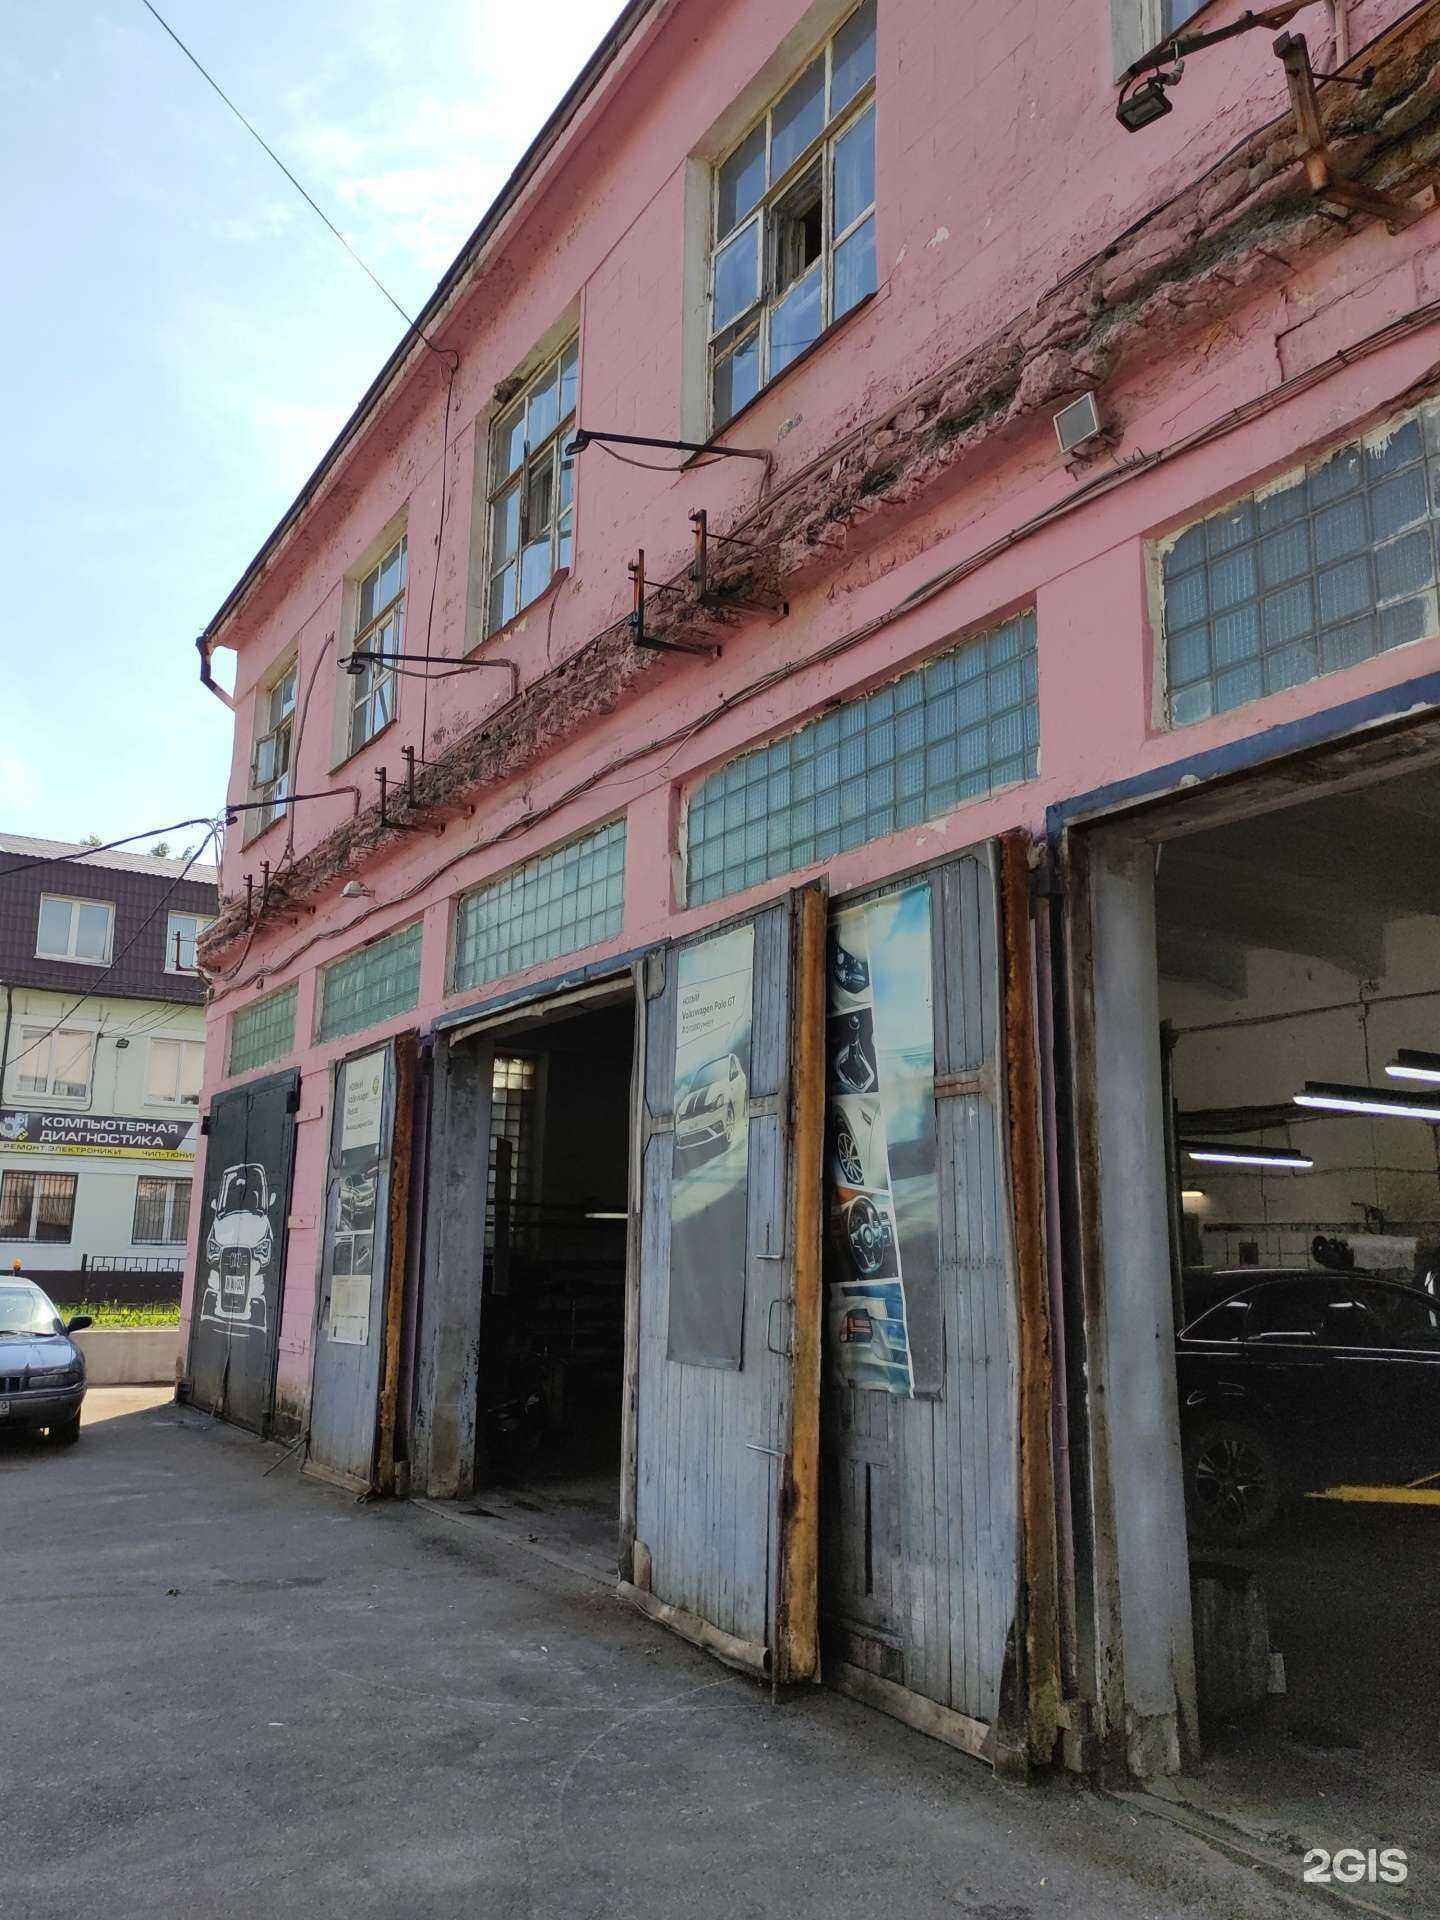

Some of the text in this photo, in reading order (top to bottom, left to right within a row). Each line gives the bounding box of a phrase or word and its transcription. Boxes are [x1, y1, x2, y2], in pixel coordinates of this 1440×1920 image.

[681, 995, 736, 1020] Volkswagen Polo GT
[41, 1116, 178, 1134] КОМПЬЮТЕРНАЯ
[39, 1130, 164, 1147] ДИАГНОСТИКА
[3, 1143, 44, 1152] РЕМОНТ
[48, 1145, 122, 1156] ЭЛЕКТРОНИКИ
